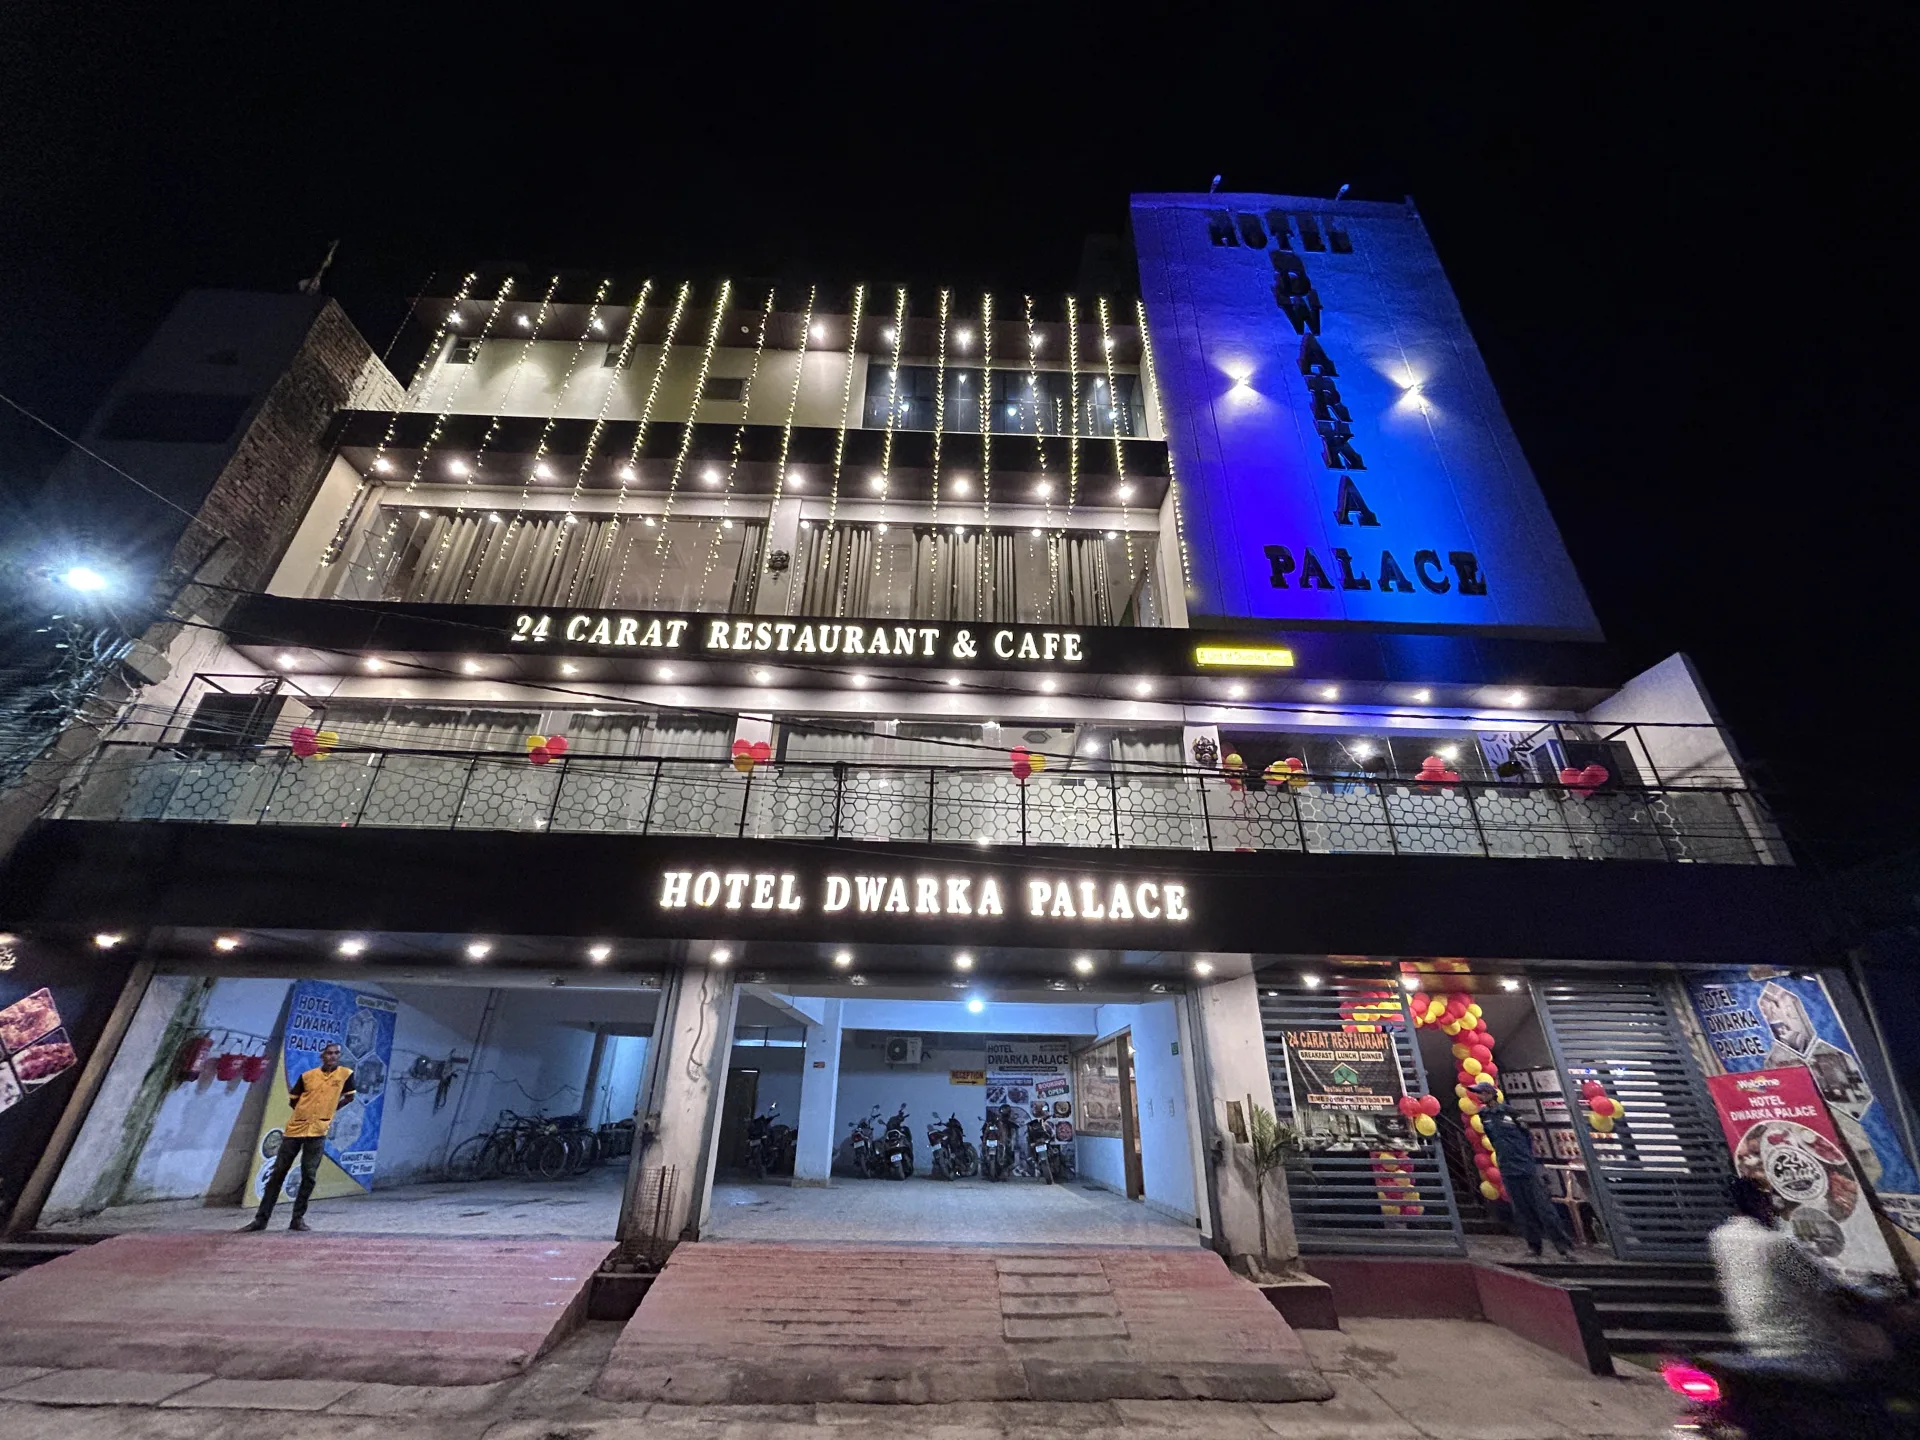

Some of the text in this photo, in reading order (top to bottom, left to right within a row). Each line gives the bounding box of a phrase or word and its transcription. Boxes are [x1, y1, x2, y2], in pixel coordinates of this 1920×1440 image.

[1208, 209, 1353, 254] HOTEL
[1269, 250, 1382, 527] DWARKA
[1263, 544, 1488, 596] PALACE
[511, 614, 1084, 661] 24 CARAT RESTAURANT & CAFE
[659, 872, 1189, 920] HOTEL DWARKA PALACE
[299, 996, 334, 1015] HOTEL
[1699, 988, 1737, 1012] HOTEL
[293, 1014, 342, 1034] DWARKA
[1705, 1009, 1760, 1034] DWARKA
[987, 1044, 1013, 1054] HOTEL
[1299, 1032, 1329, 1048] CARAT
[1330, 1032, 1389, 1050] RESTAURANT
[1716, 1036, 1766, 1059] PALACE
[987, 1054, 1069, 1065] DWARKA PALACE
[1300, 1051, 1333, 1059] BREAKFAST
[951, 1070, 984, 1079] RECEPTION
[1038, 1080, 1065, 1091] BOOKING
[1047, 1087, 1065, 1096] OPEN
[1737, 1078, 1780, 1090] Welcome
[1748, 1095, 1786, 1107] HOTEL
[1730, 1105, 1817, 1121] DWARKA PALACE
